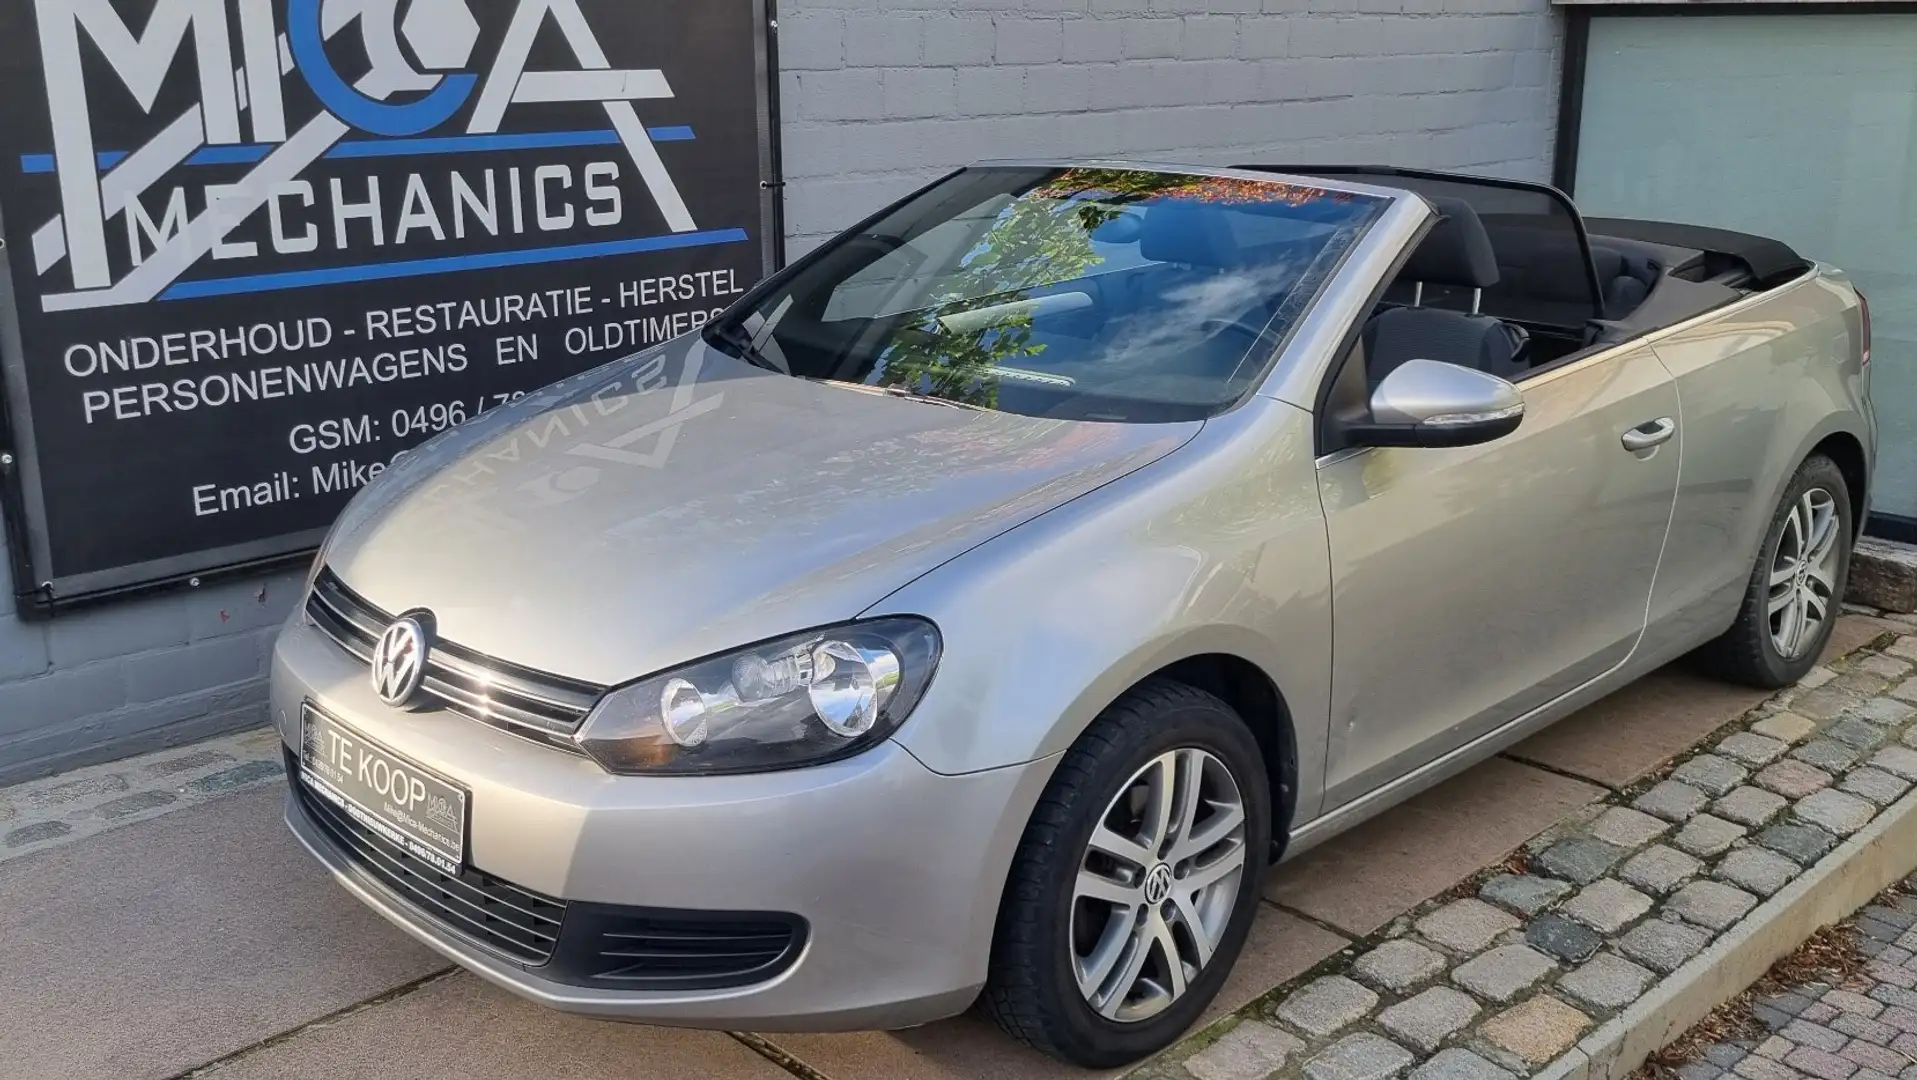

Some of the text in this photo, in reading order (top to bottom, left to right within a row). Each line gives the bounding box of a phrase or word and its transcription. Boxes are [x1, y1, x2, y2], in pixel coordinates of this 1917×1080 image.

[124, 161, 622, 267] MECHANICS
[64, 317, 331, 377] ONDERHOUD
[366, 286, 593, 341] RESTAURATIE
[619, 268, 744, 308] HERSTEL
[83, 343, 468, 424] PERSONENWAGENS
[496, 334, 538, 366] EN
[289, 414, 381, 454] GSM:
[391, 399, 467, 437] 0496
[192, 449, 409, 517] Email: Mike
[327, 729, 426, 812] TE KOOP
